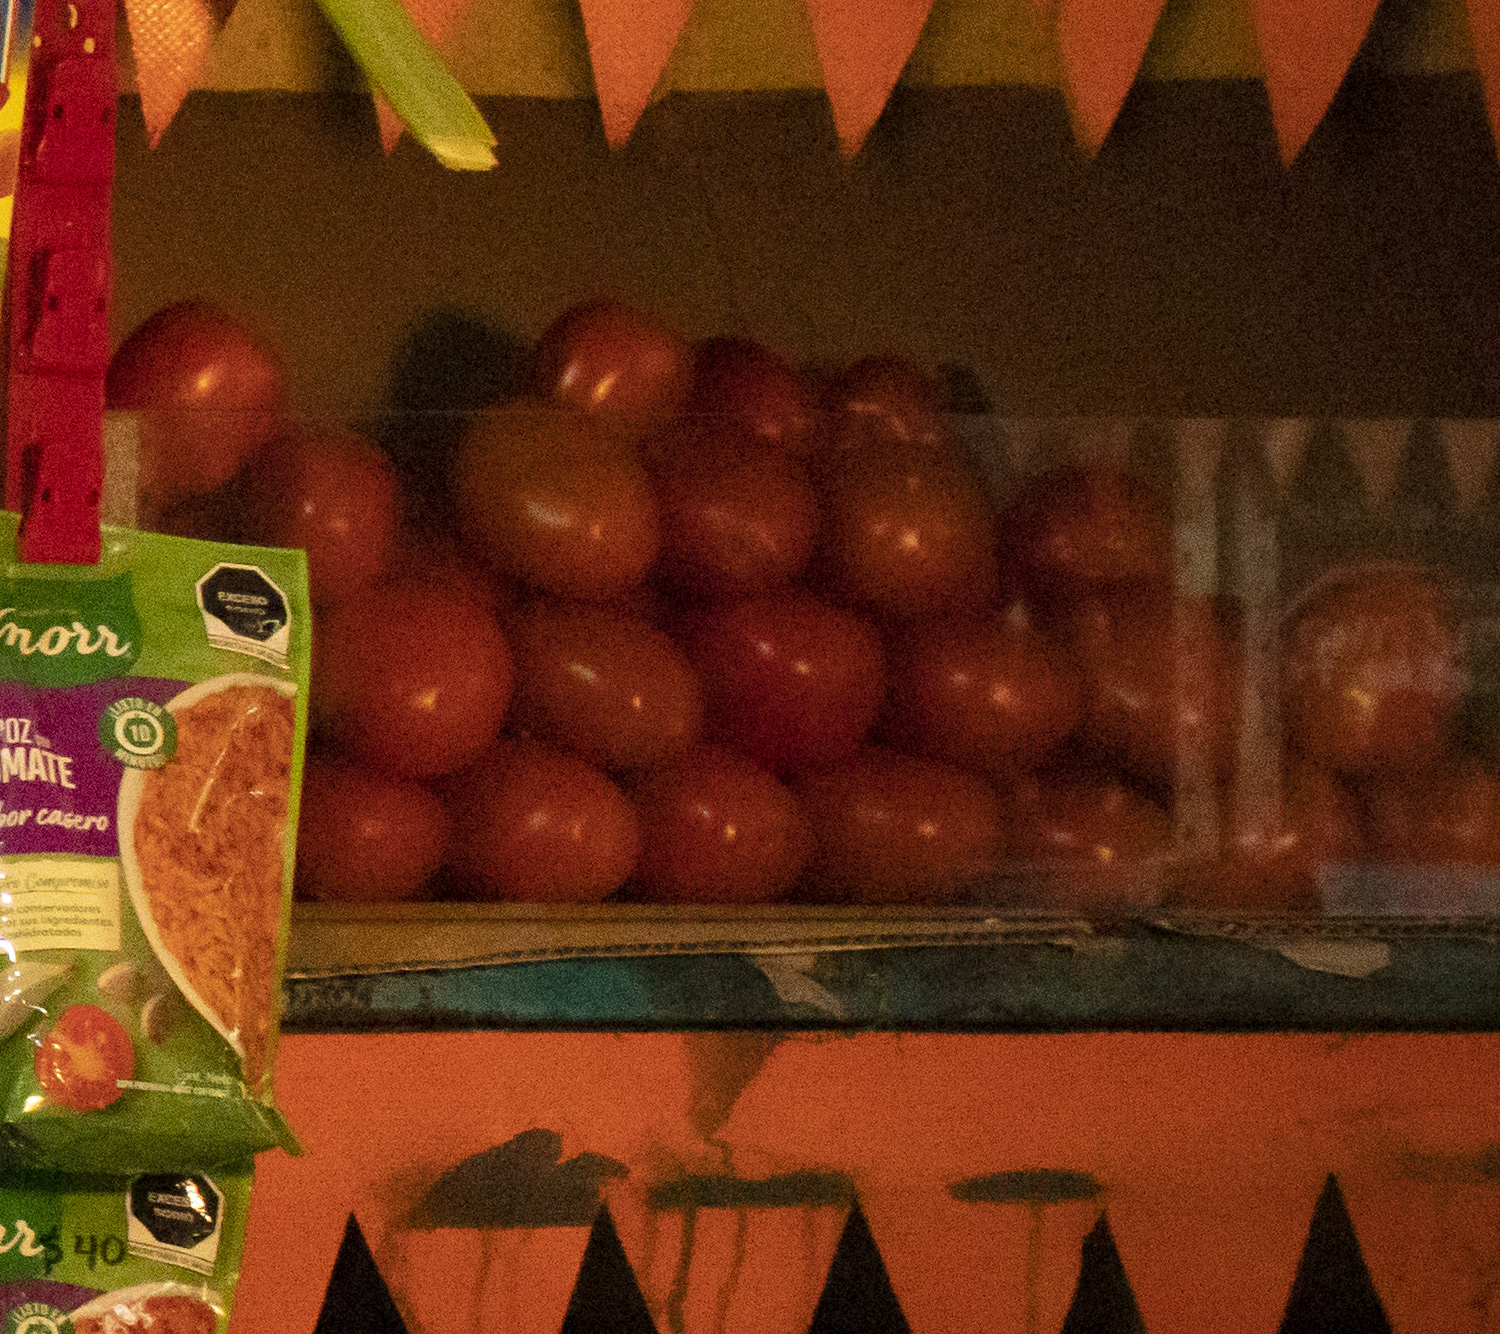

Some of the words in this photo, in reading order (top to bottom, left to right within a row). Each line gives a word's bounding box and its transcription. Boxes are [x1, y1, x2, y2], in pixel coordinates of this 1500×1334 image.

[129, 724, 151, 743] 10
[36, 806, 110, 832] casero
[74, 1233, 127, 1271] 40
